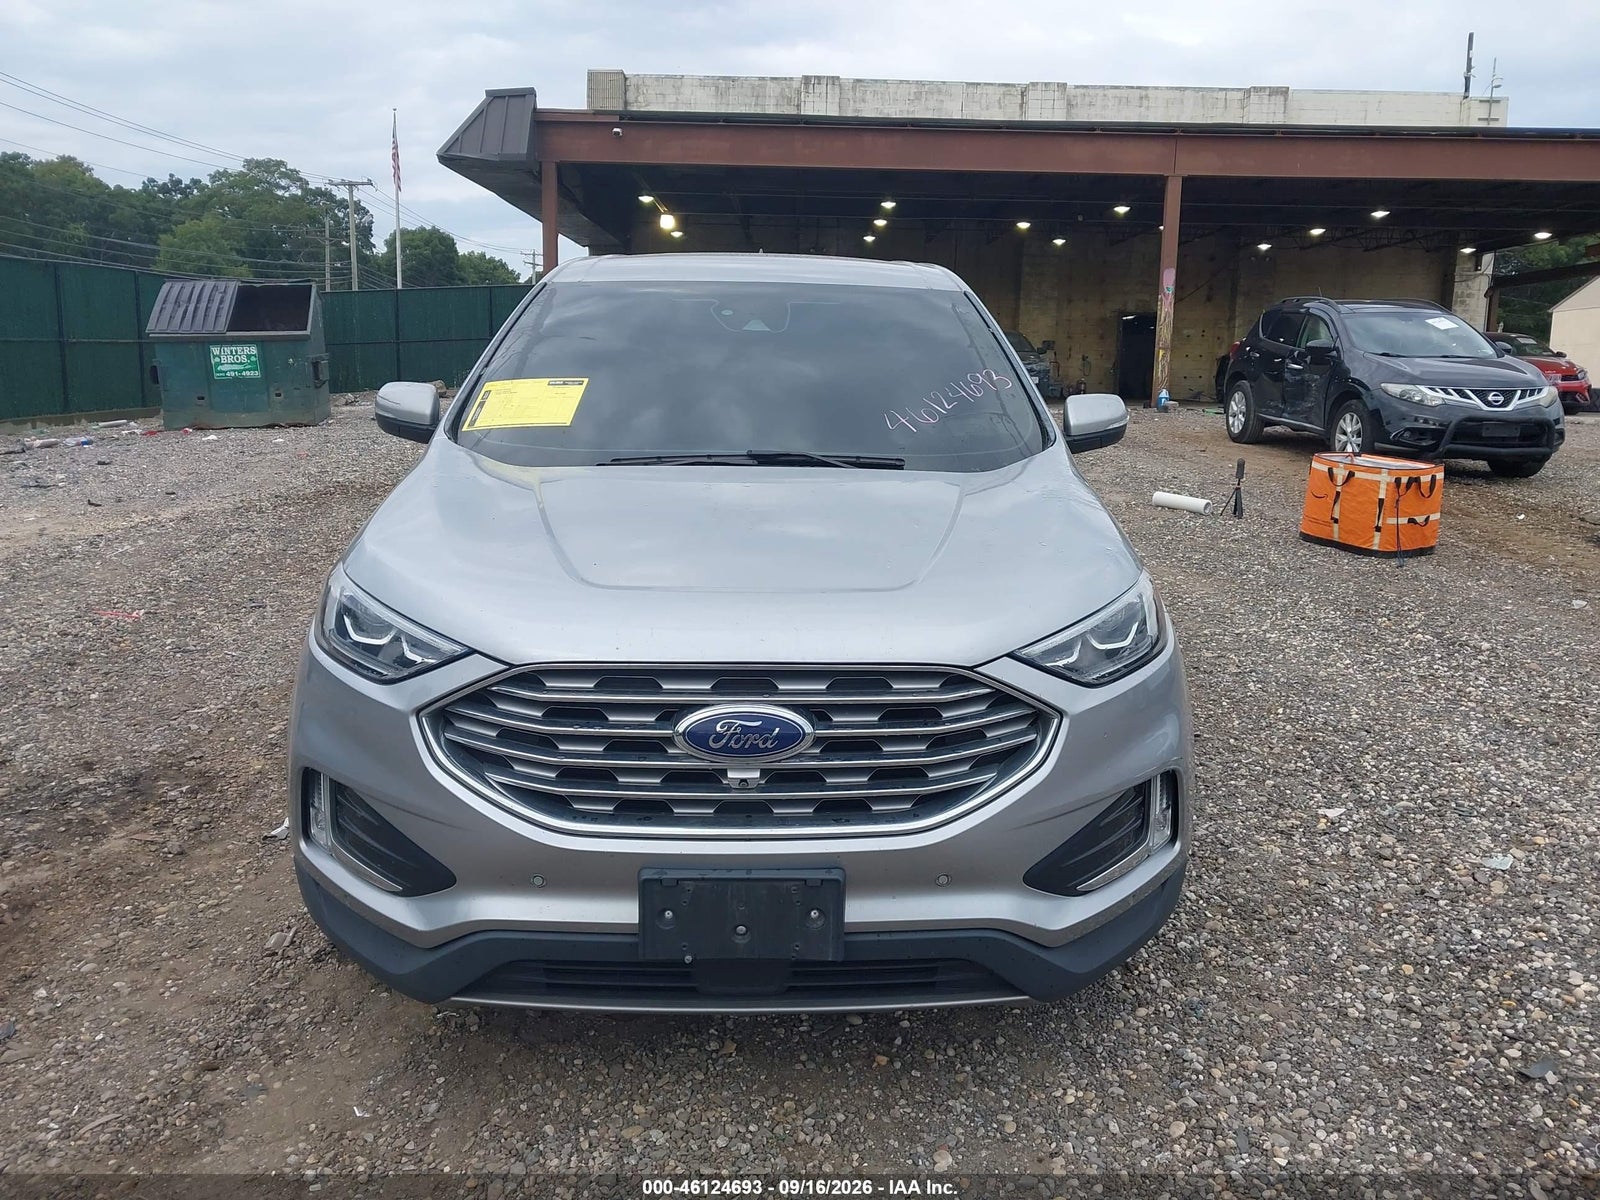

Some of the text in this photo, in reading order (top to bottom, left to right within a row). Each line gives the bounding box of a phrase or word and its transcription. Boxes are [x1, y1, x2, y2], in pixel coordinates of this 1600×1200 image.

[211, 346, 257, 355] WINTERS
[220, 354, 251, 363] BROS.
[884, 369, 1012, 433] 46124693
[708, 719, 780, 749] Ford
